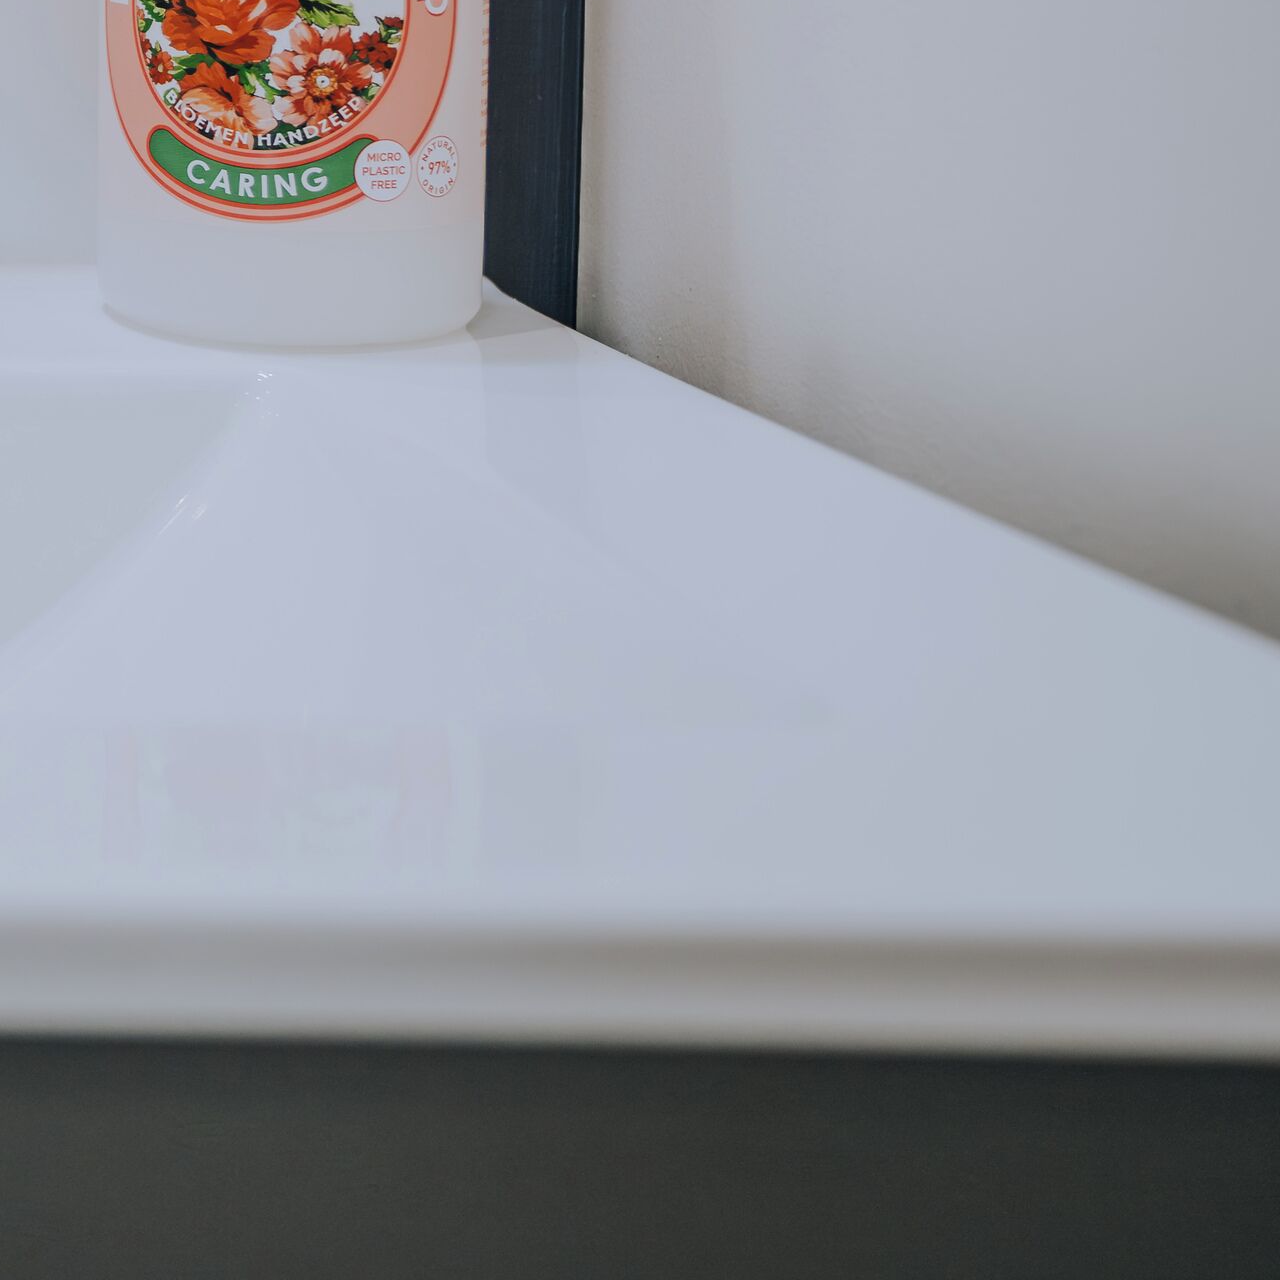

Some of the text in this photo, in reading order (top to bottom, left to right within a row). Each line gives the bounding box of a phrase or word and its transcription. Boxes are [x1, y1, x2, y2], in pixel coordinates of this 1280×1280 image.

[165, 88, 363, 147] BLOEMEN HANDZEEP
[366, 152, 402, 163] MICRO
[421, 140, 456, 162] NATURAL
[361, 165, 406, 177] PLASTIC
[427, 160, 452, 176] 97%
[186, 158, 329, 199] CARING
[370, 179, 398, 190] FREE
[422, 177, 457, 195] ORIGIN
